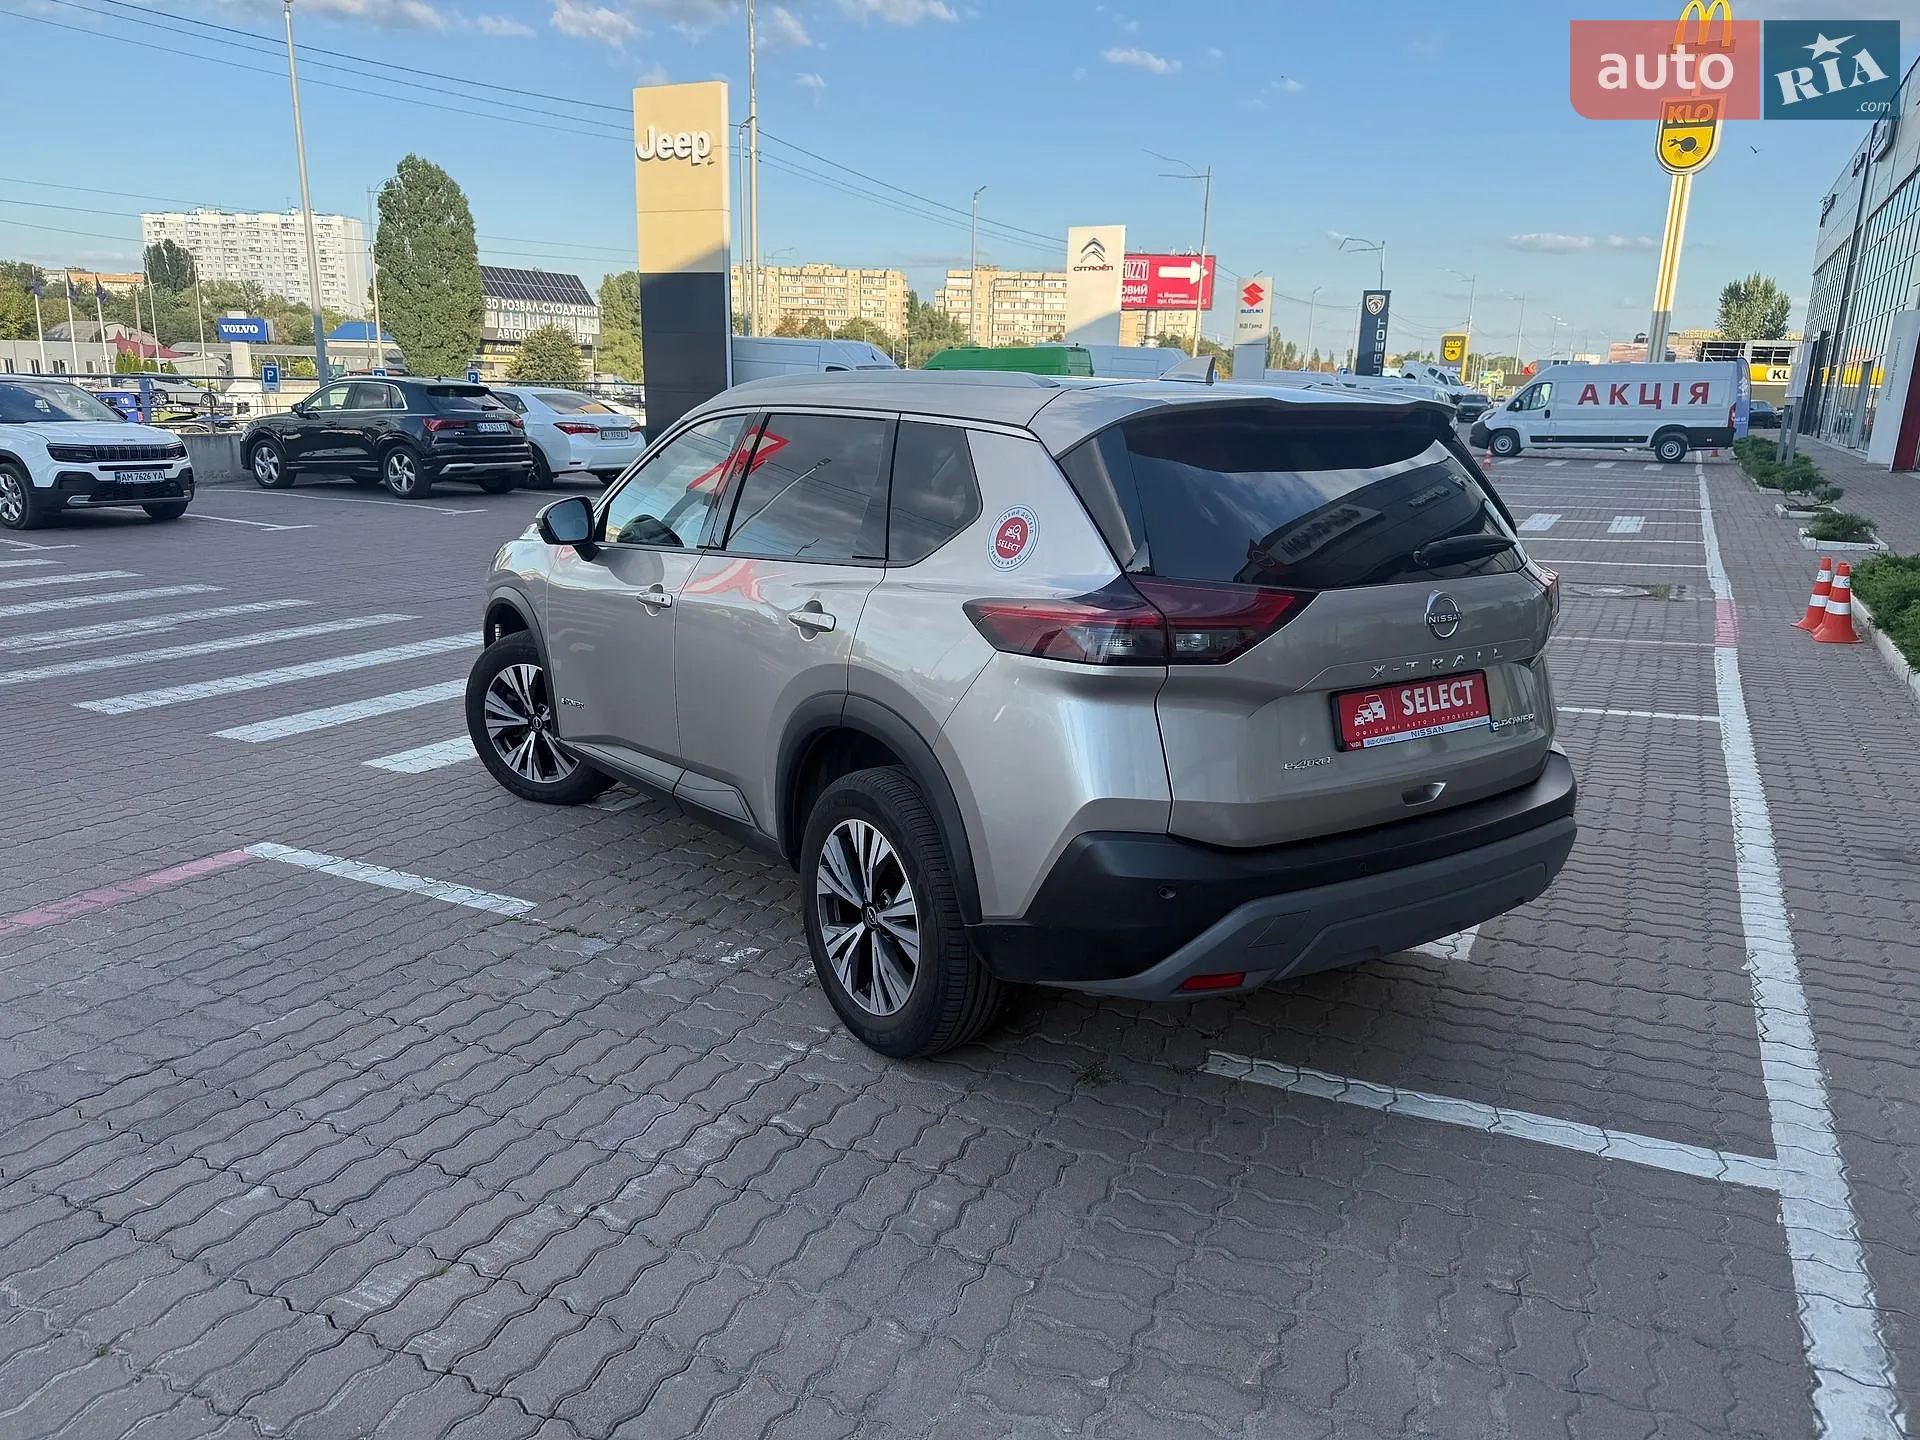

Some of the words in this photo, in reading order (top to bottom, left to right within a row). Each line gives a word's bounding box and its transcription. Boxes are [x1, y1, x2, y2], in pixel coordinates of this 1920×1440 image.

[1667, 103, 1714, 124] KLO
[636, 125, 711, 167] Jeep
[486, 298, 499, 310] 3D
[501, 299, 598, 317] РОЗВАЛ-СХОДЖЕННЯ
[221, 324, 259, 334] VOLVO
[1577, 382, 1710, 410] АКЦІЯ
[121, 473, 134, 481] AM
[135, 472, 151, 481] 7626
[997, 539, 1021, 552] SELECT
[1428, 612, 1462, 624] NISSAN
[1370, 648, 1504, 679] X-TRAIL
[1400, 680, 1474, 716] SELECT
[1406, 719, 1427, 728] АВТО
[1410, 725, 1446, 738] NISSAN
